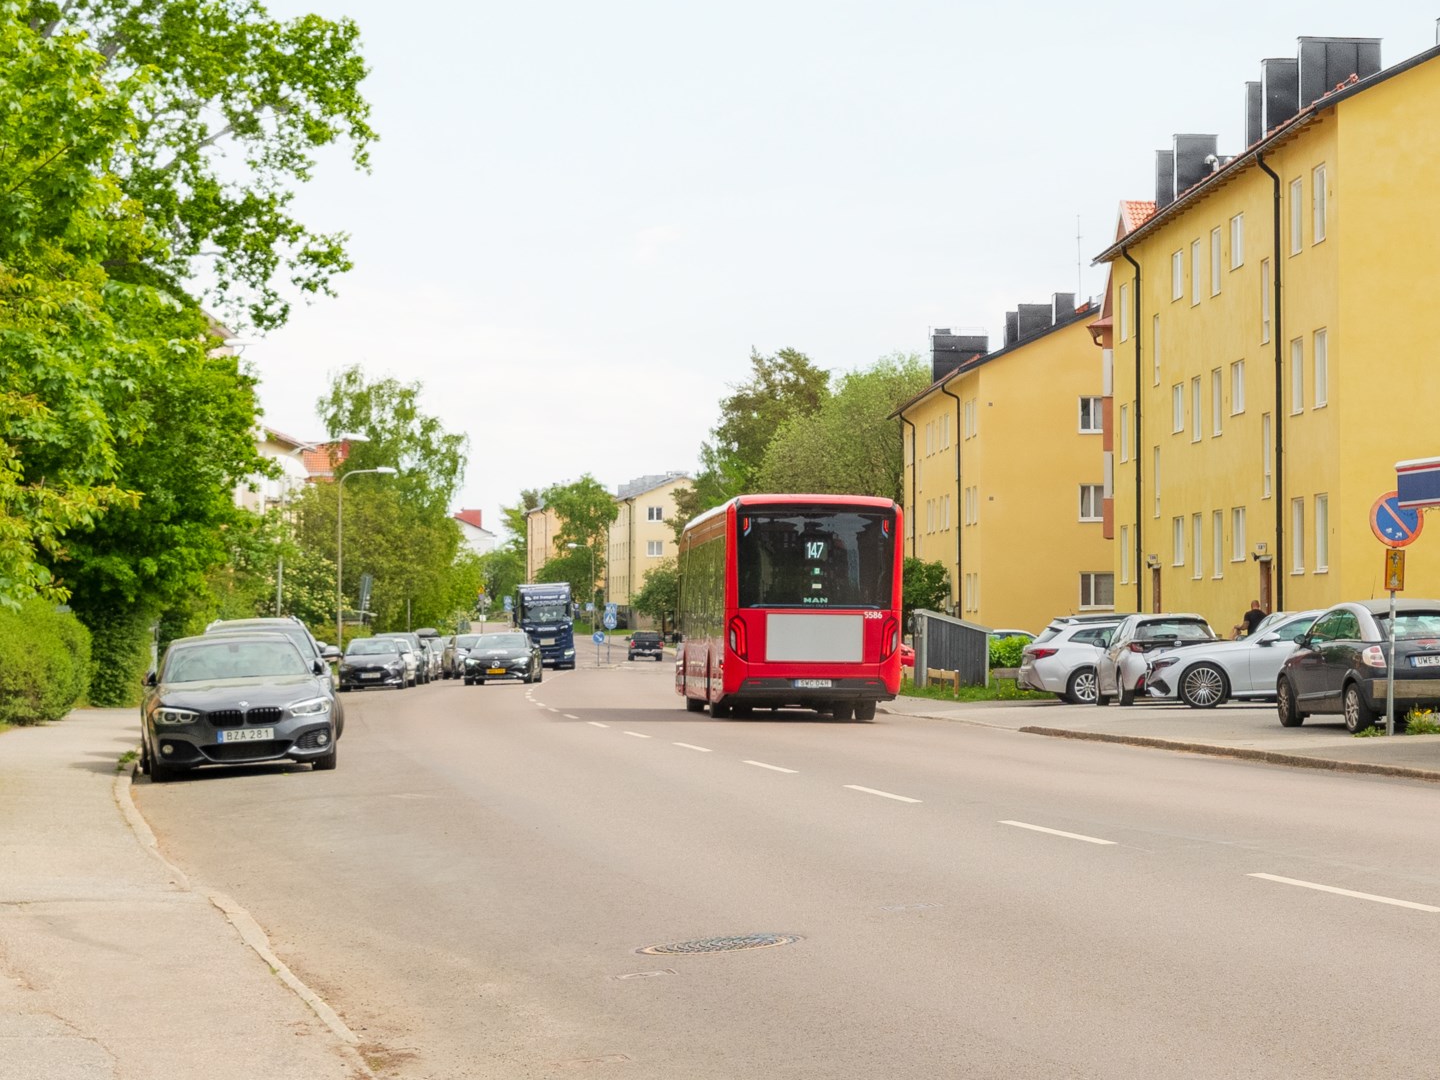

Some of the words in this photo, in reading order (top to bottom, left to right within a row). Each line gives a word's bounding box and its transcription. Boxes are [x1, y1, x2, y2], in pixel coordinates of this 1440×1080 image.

[806, 541, 824, 559] 147
[863, 611, 883, 619] 5586
[1417, 656, 1432, 664] UWE
[226, 731, 246, 741] BZA
[249, 729, 269, 740] 281
